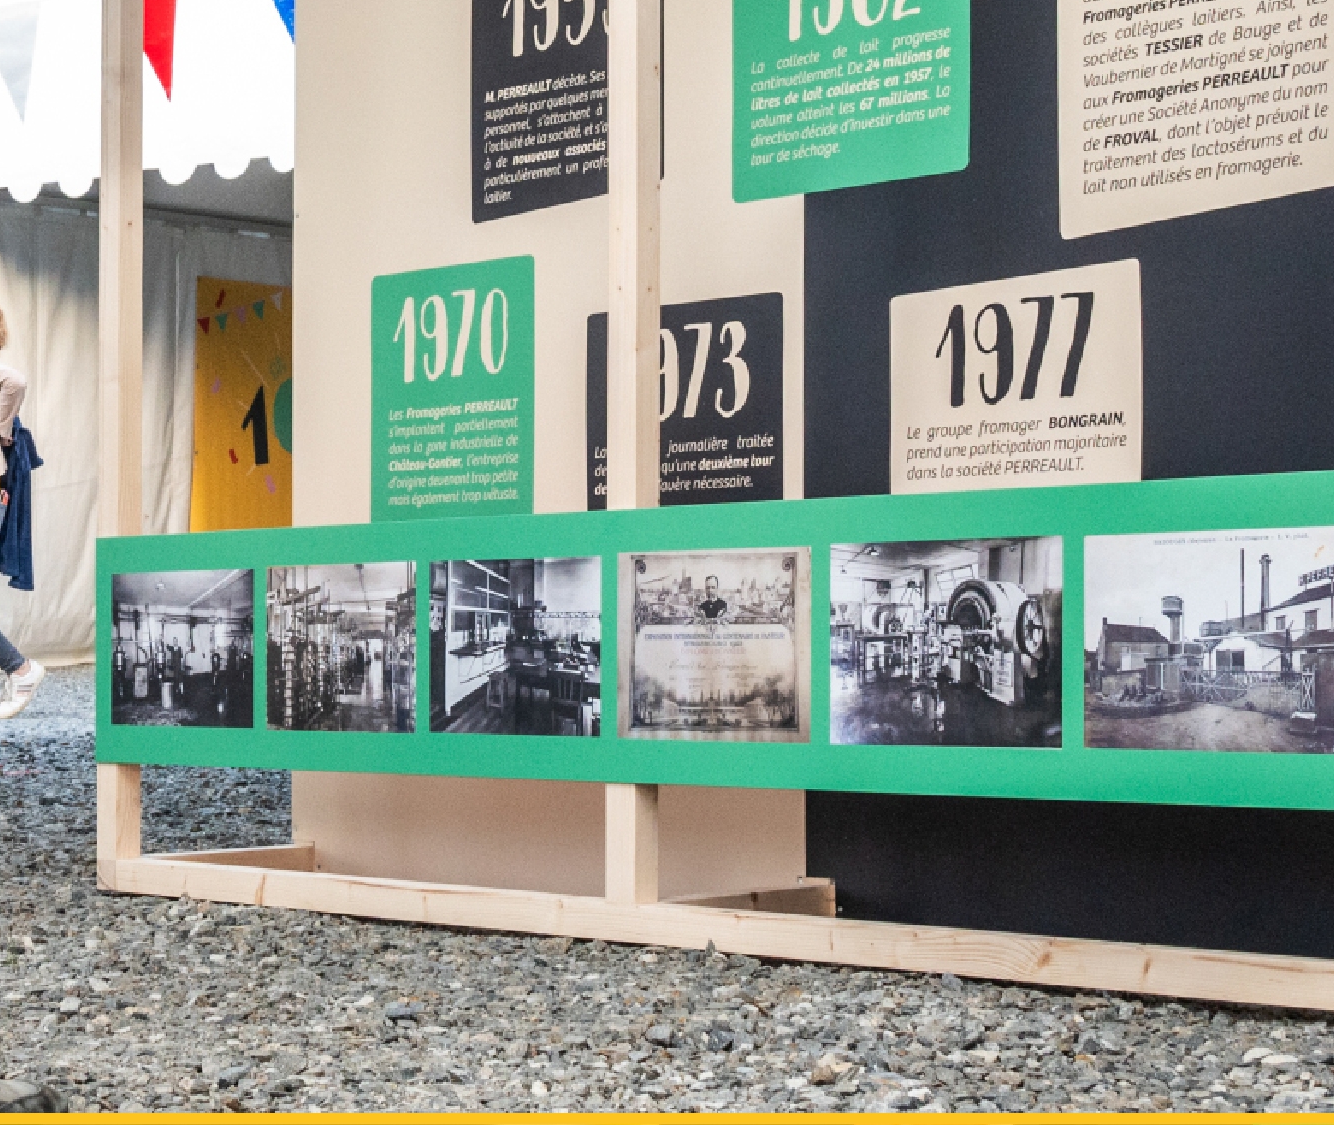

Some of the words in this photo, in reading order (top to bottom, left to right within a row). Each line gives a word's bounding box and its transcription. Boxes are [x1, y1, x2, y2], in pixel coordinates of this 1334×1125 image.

[1083, 0, 1165, 23] Fromageries
[1083, 32, 1107, 45] des
[1115, 18, 1182, 40] collègues
[1192, 8, 1245, 26] laitiers.
[1256, 0, 1295, 14] Ainsi,
[1084, 45, 1138, 67] sociétés
[1146, 35, 1203, 56] TESSIER
[1209, 30, 1226, 45] de
[1233, 23, 1281, 40] Bauge
[1288, 16, 1302, 32] et
[1310, 13, 1327, 28] de
[1084, 66, 1158, 88] Vaubernier
[1161, 61, 1177, 74] de
[1180, 49, 1245, 71] Martigné
[1249, 49, 1264, 61] se
[1264, 33, 1327, 62] joignent
[1083, 115, 1117, 131] créer
[1120, 112, 1144, 124] une
[1148, 100, 1197, 121] Société
[1199, 91, 1269, 112] Anonyme
[1273, 86, 1290, 101] du
[1295, 83, 1327, 97] nom
[1084, 97, 1108, 109] aux
[1112, 79, 1199, 103] Fromageries
[1203, 64, 1289, 90] PERREAULT
[1292, 59, 1329, 79] pour
[1083, 139, 1100, 151] de
[1105, 129, 1161, 148] FROVAL,
[1168, 121, 1201, 139] dont
[1206, 114, 1251, 134] l'objet
[1256, 105, 1309, 129] prévoit
[1315, 103, 1327, 117] le
[1083, 150, 1157, 174] traitement
[1161, 148, 1185, 162] des
[1192, 134, 1283, 158] lactosérums
[1288, 129, 1302, 144] et
[1309, 126, 1327, 141] du
[1083, 179, 1105, 194] lait
[1110, 177, 1136, 191] non
[1141, 168, 1191, 187] utilisés
[1196, 167, 1211, 179] en
[1216, 153, 1302, 180] fromagerie.
[393, 288, 509, 383] 1970
[935, 291, 1094, 408] 1977
[659, 321, 750, 423] 973
[907, 427, 920, 439] Le
[927, 425, 972, 442] groupe
[978, 420, 1042, 437] fromager
[1049, 412, 1126, 428] BONGRAIN,
[907, 447, 941, 463] prend
[944, 446, 966, 457] une
[970, 439, 1050, 458] participation
[1054, 434, 1127, 452] majoritaire
[907, 466, 936, 480] dans
[941, 464, 953, 478] la
[956, 461, 1001, 476] société
[1004, 458, 1084, 473] PERREAULT.
